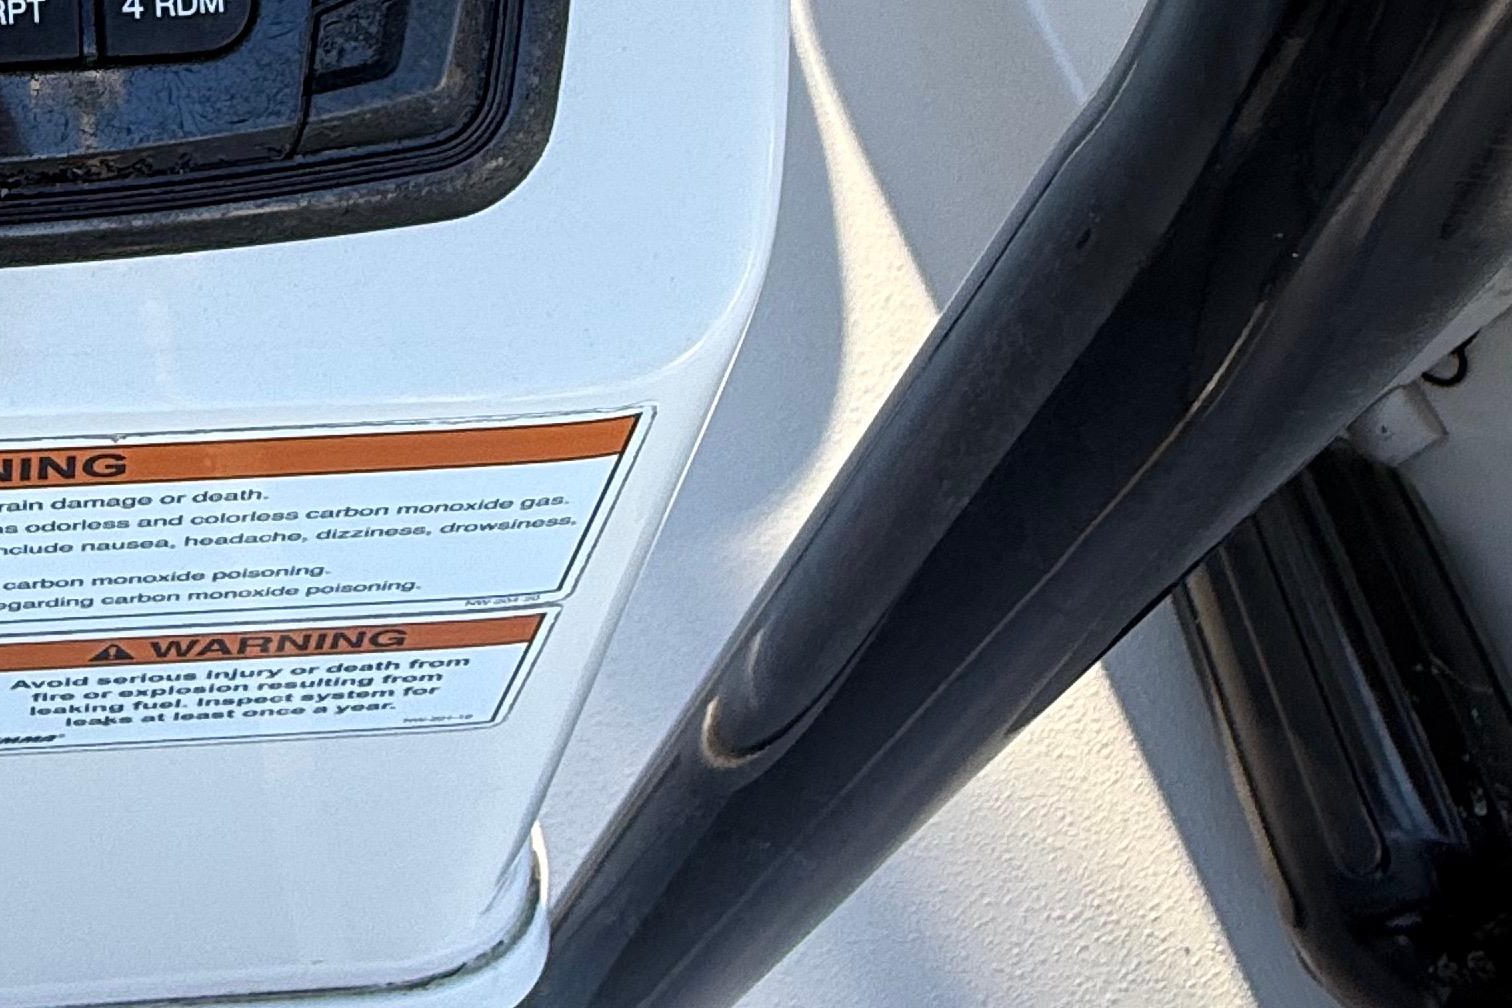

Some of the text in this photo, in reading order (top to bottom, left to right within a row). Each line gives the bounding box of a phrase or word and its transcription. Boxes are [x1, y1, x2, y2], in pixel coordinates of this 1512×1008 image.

[50, 494, 153, 511] damage
[159, 493, 186, 504] or
[192, 489, 269, 503] death.
[25, 519, 130, 534] odorless
[137, 515, 183, 528] and
[190, 509, 299, 526] colorless
[305, 504, 389, 520] carbon
[396, 497, 514, 514] monoxide
[3, 576, 84, 591] carbon
[91, 570, 205, 587] monoxide
[212, 563, 332, 581] poisoning.
[100, 590, 180, 604] carbon
[187, 583, 299, 601] monoxide
[306, 580, 422, 596] poisoning.
[151, 629, 408, 658] WARNING
[10, 657, 470, 690] Avoid serious injury or death from
[31, 672, 443, 702] fire or explosion resulting from
[29, 685, 440, 715] leaking fuel. Inspect system for
[65, 701, 396, 727] leaks at least once a year.
